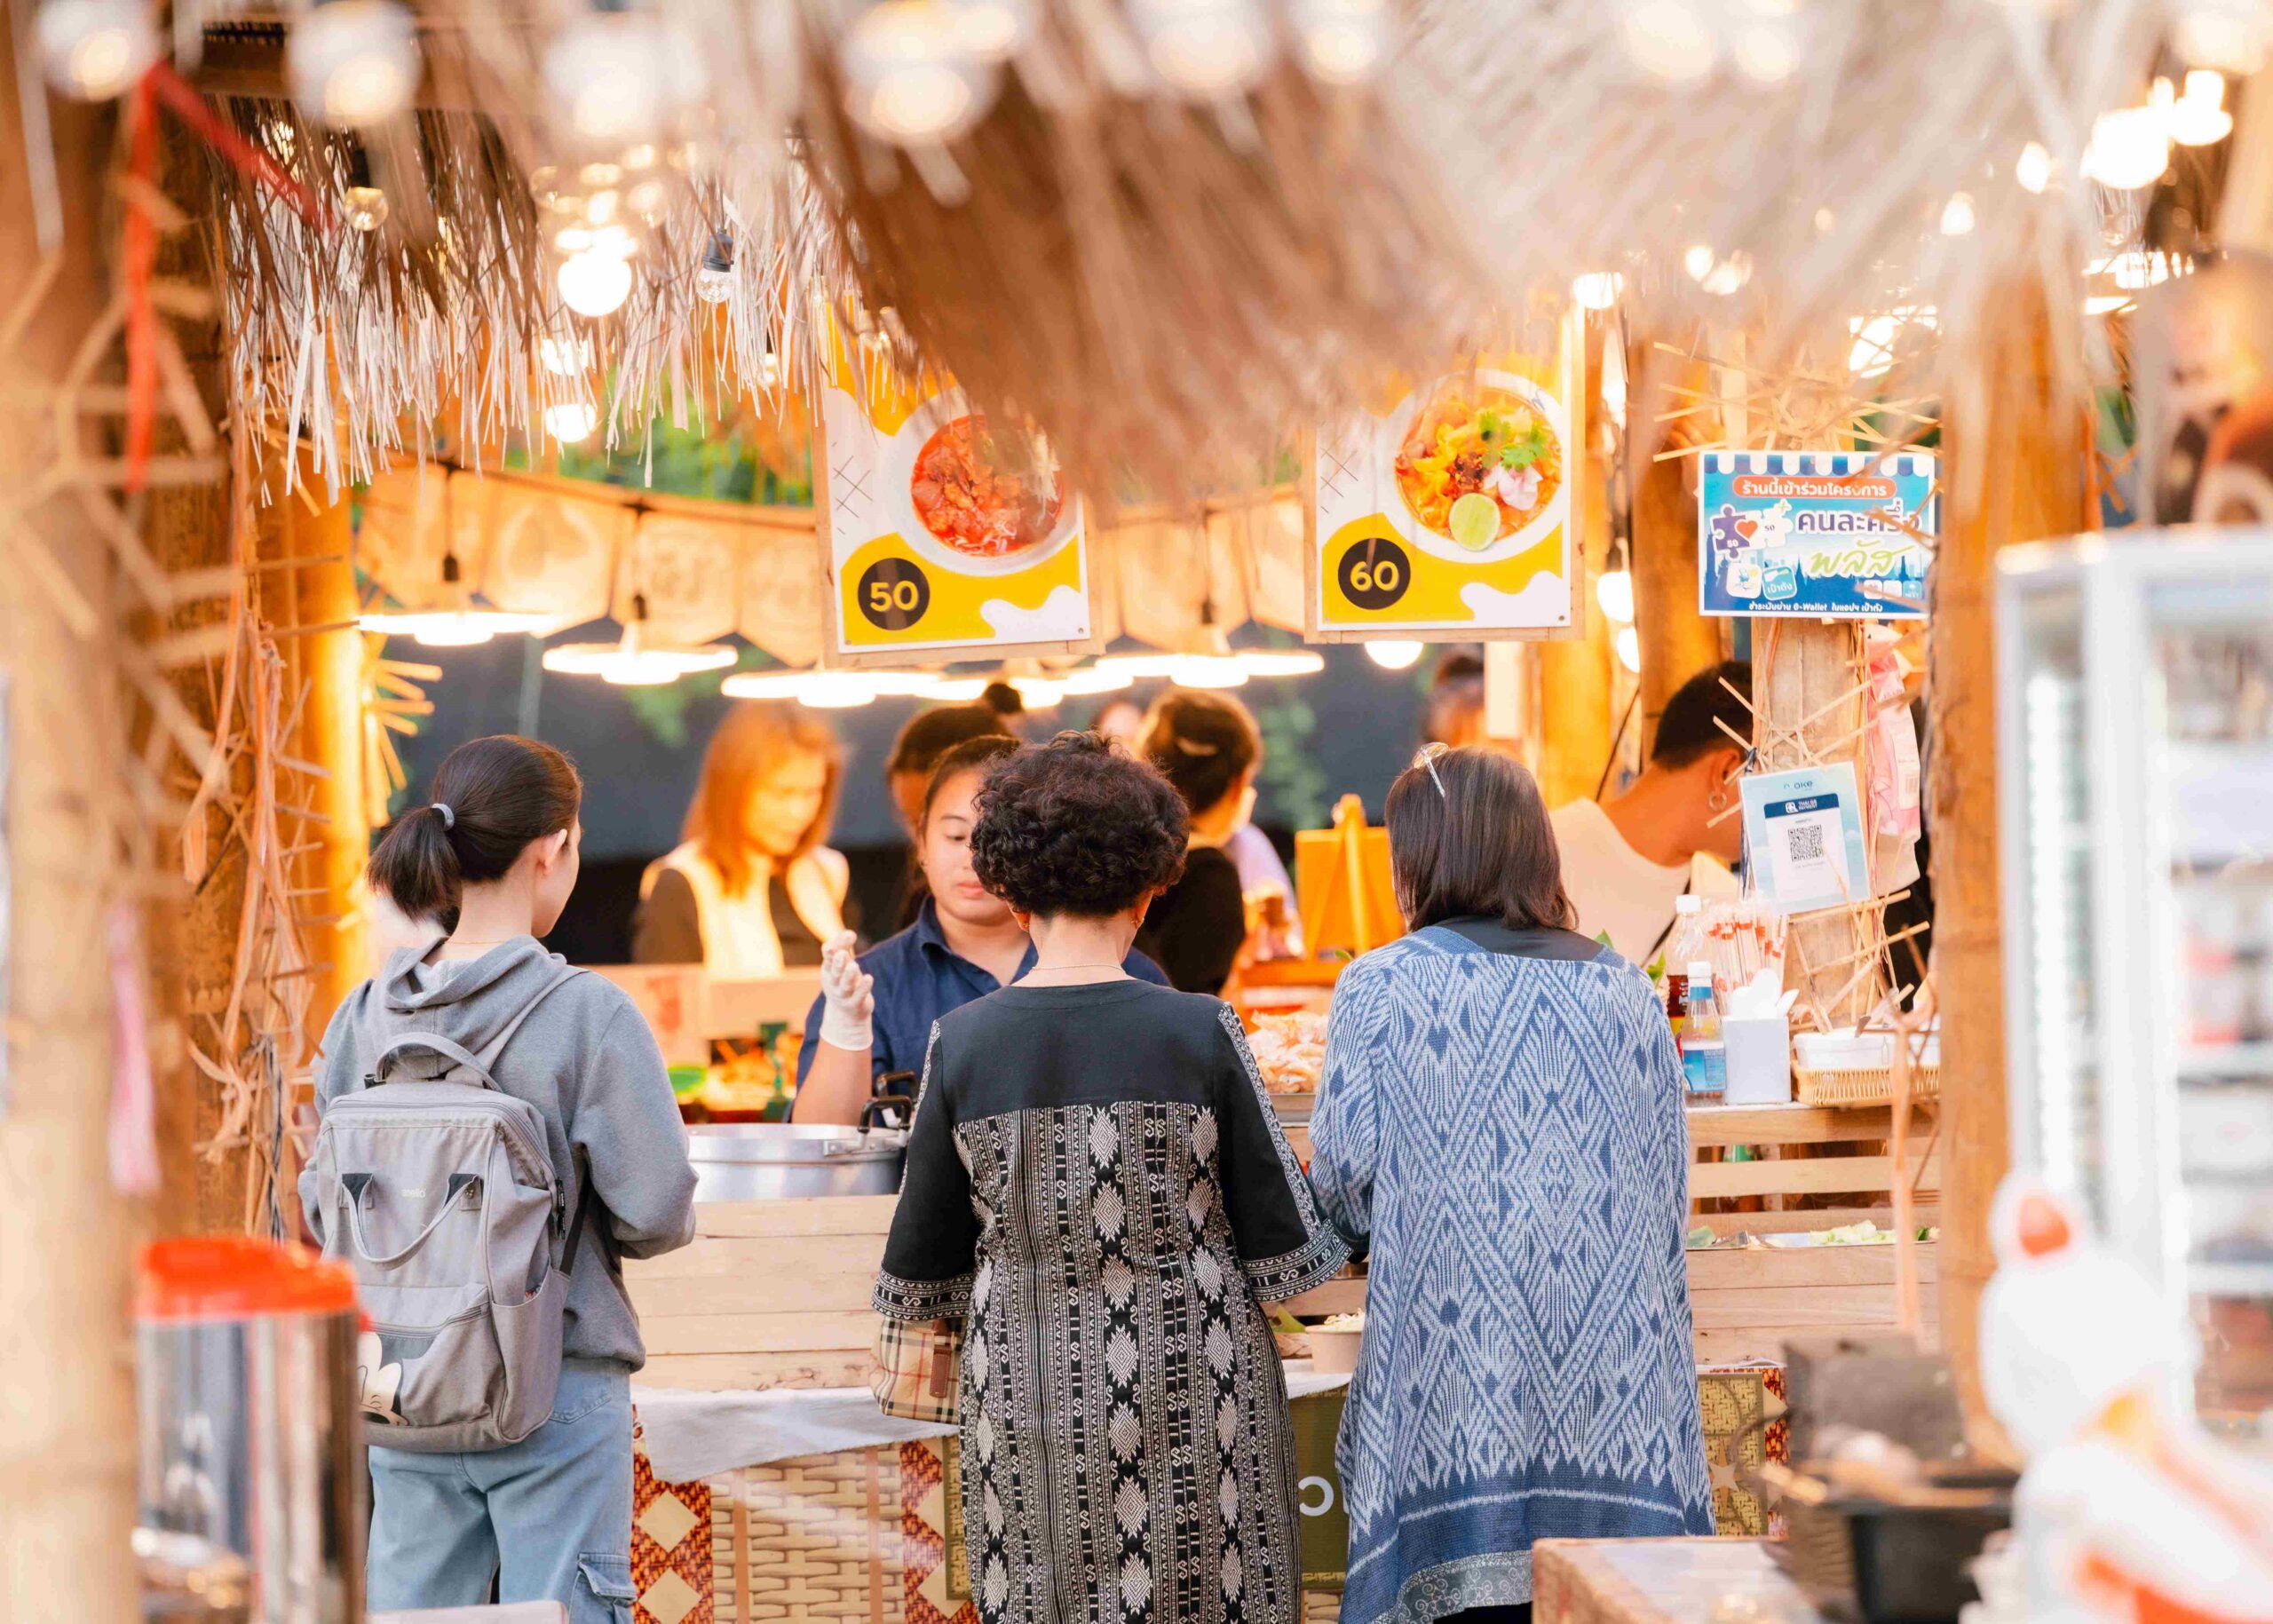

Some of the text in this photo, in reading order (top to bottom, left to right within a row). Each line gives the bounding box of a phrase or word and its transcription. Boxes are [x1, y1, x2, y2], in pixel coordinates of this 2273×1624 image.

[1727, 539, 1738, 548] 50
[1810, 539, 1915, 574] พลัส
[1350, 560, 1400, 592] 60
[870, 581, 920, 613] 50
